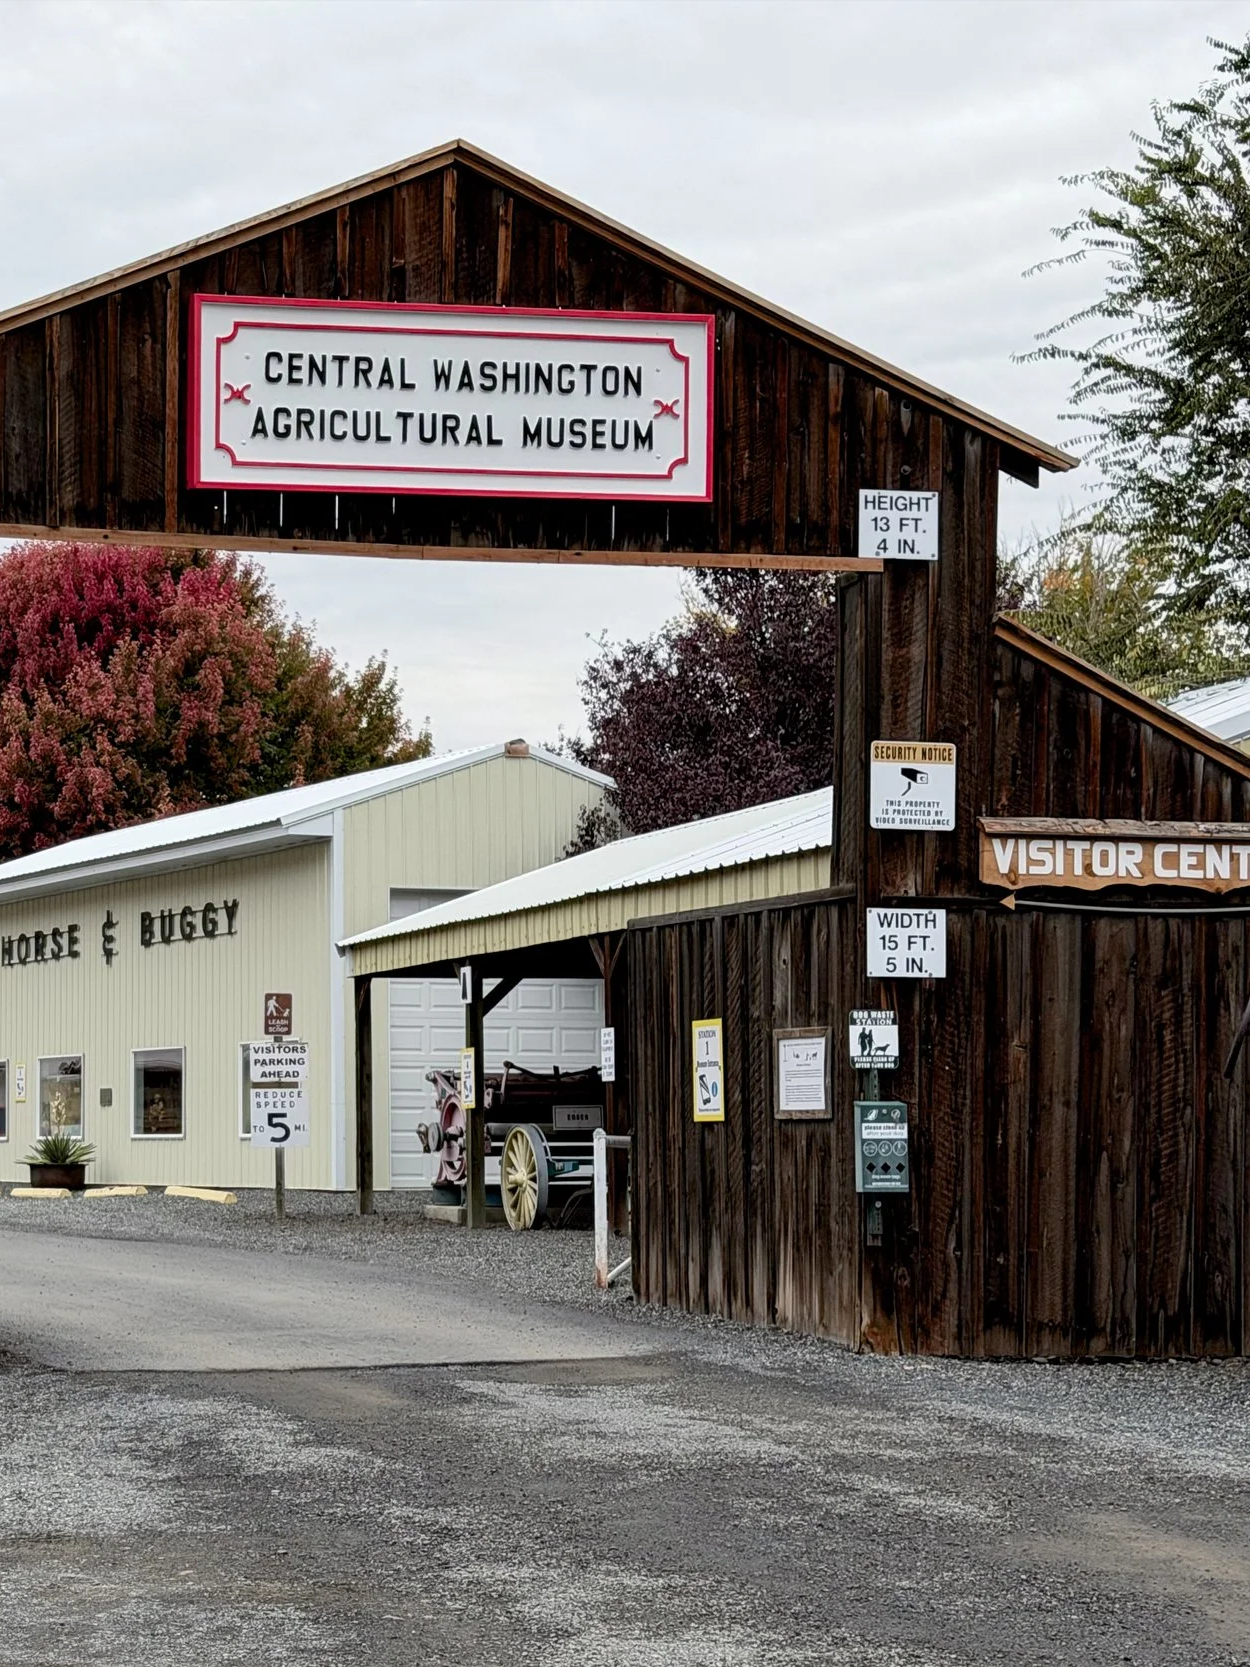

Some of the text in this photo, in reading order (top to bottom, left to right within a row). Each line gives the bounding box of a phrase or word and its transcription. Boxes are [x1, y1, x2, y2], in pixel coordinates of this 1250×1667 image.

[264, 351, 643, 397] CENTRAL WASHINGTON
[250, 406, 654, 452] AGRICULTURAL MUSEUM
[863, 494, 934, 513] HEIGHT
[870, 516, 927, 534] 13 FT.
[876, 538, 920, 556] 4 IN.
[874, 745, 953, 762] SECURITY NOTICE
[886, 799, 940, 808] THIS PROPERTY
[892, 808, 932, 817] PROTECTED
[875, 817, 951, 826] VIDEO SURVEILLANCE
[991, 839, 1143, 877] VISITOR
[876, 912, 938, 930] WIDTH
[0, 898, 239, 968] HORSE & BUGGY
[879, 934, 935, 952] 15 FT.
[885, 957, 929, 974] 5 IN.
[855, 1018, 892, 1026] STATION
[870, 1010, 895, 1019] WASTE
[253, 1045, 307, 1055] VISITORS
[253, 1057, 306, 1067] PARKING
[260, 1070, 300, 1079] AHEAD
[255, 1090, 303, 1099] REDUCE
[256, 1100, 295, 1109] SPEED
[253, 1125, 265, 1133] TO
[267, 1112, 291, 1143] 5
